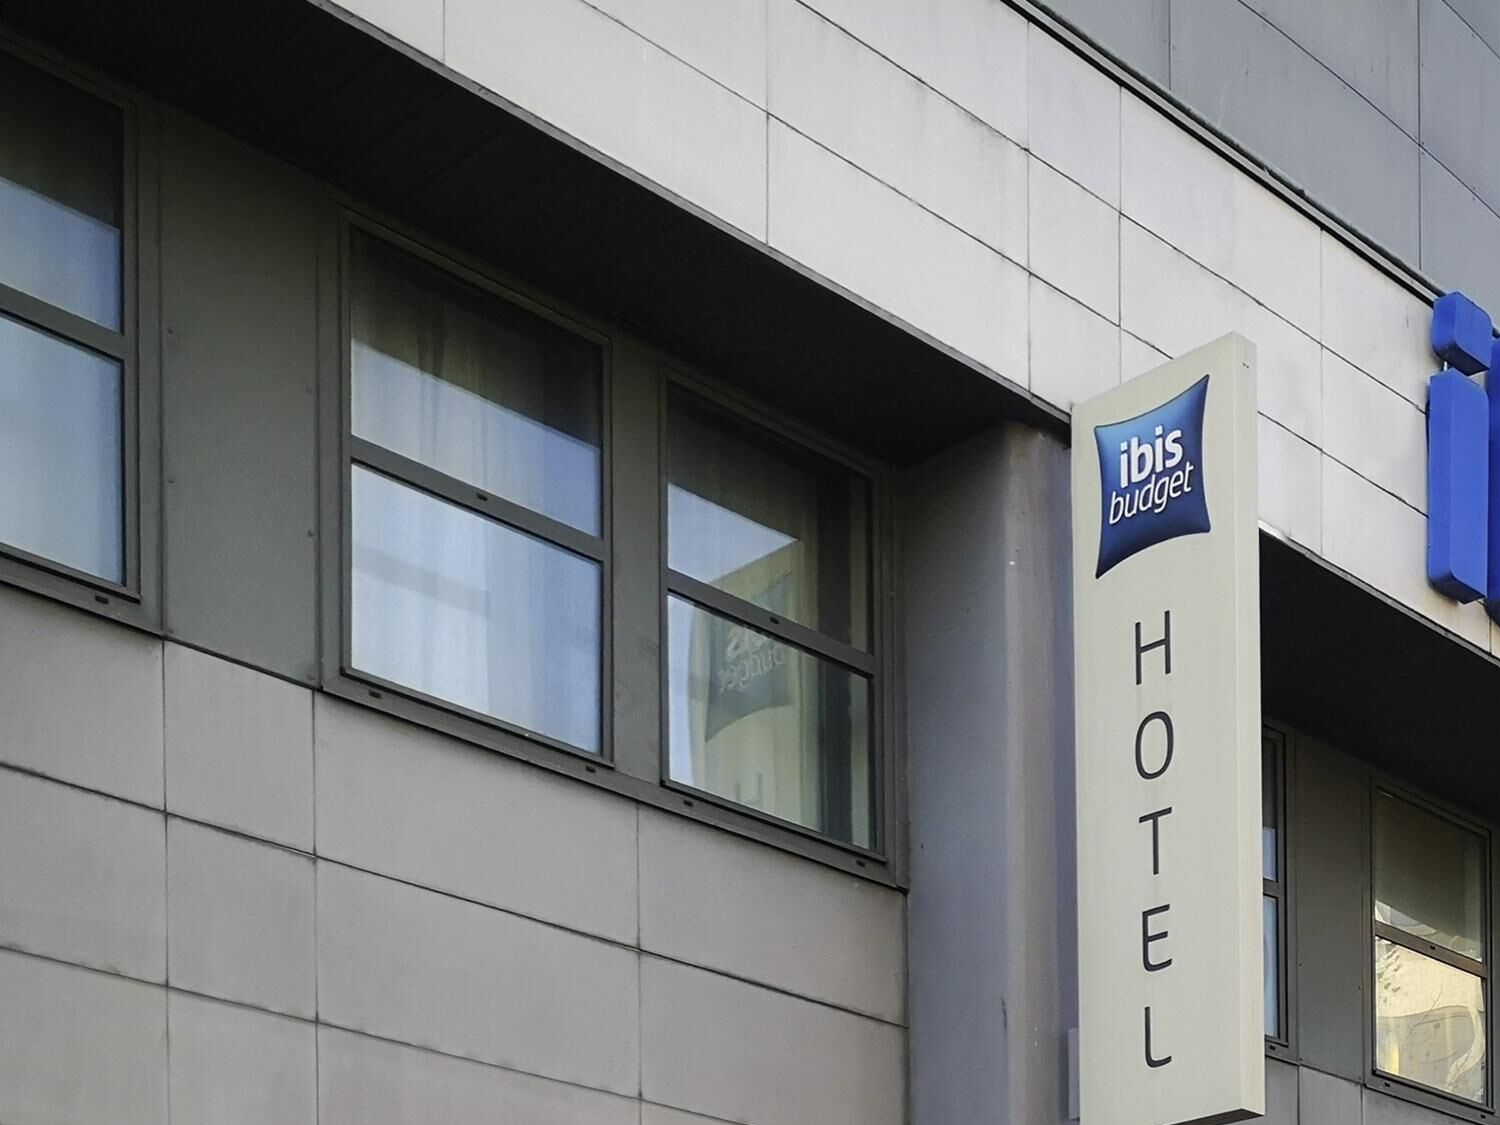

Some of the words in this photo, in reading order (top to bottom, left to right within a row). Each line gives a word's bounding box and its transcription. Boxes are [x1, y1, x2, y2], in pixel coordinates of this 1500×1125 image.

[1120, 425, 1184, 488] ibis
[1108, 461, 1195, 526] budget
[1134, 609, 1174, 1069] HOTEL
